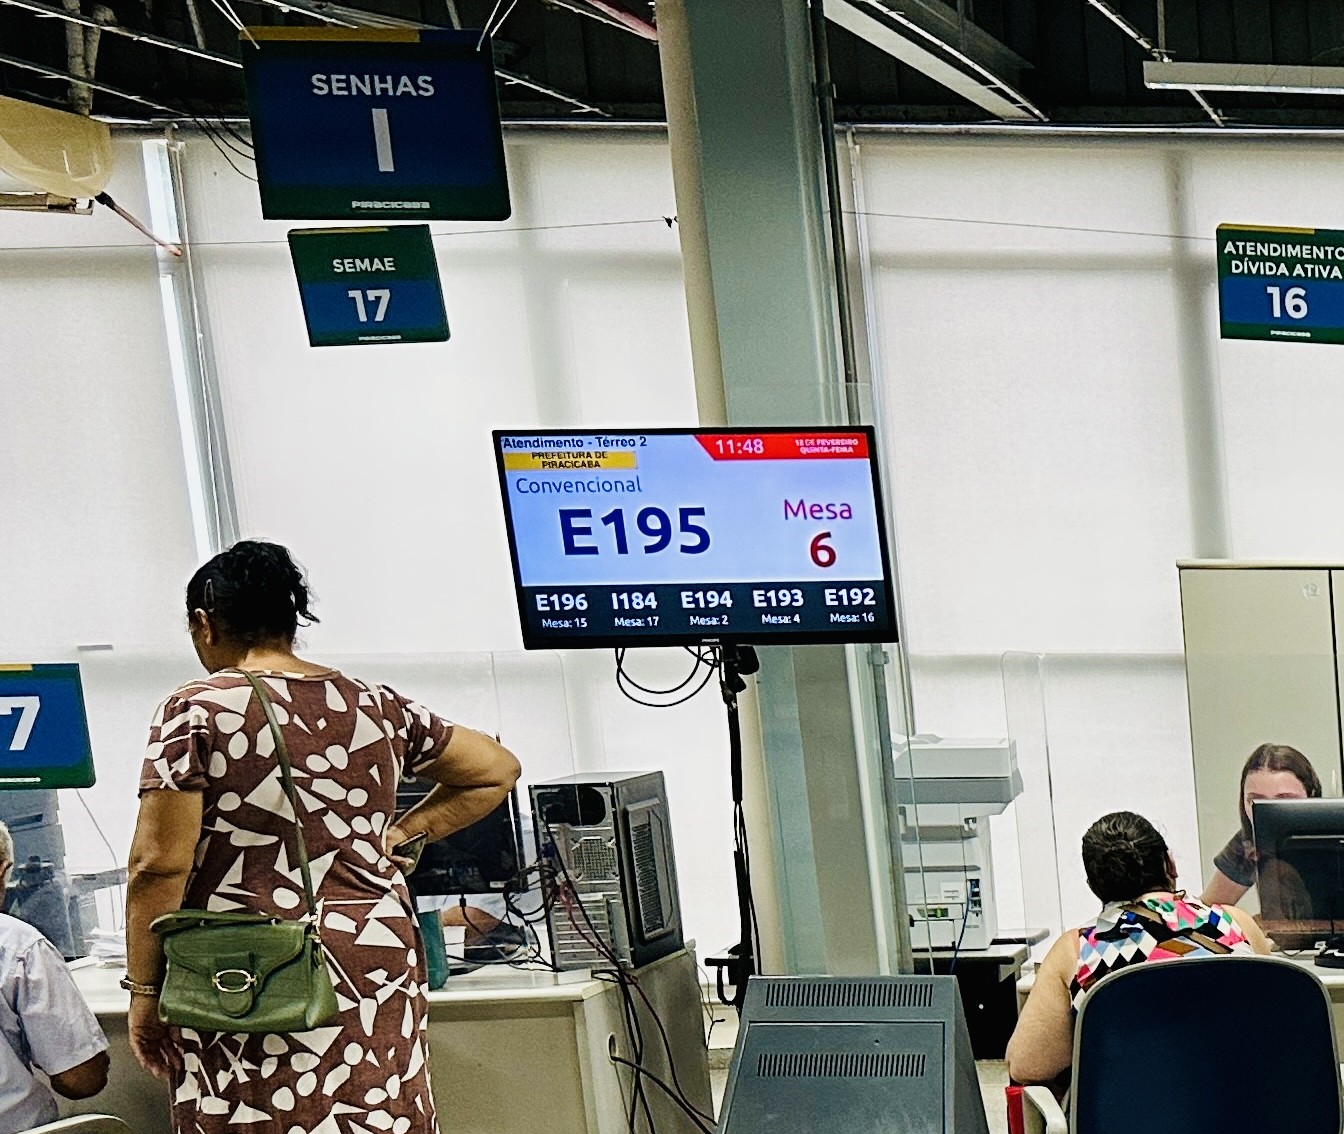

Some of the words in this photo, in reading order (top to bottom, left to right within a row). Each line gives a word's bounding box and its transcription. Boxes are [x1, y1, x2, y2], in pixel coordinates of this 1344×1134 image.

[311, 74, 435, 97] SENHAS
[372, 108, 394, 172] I
[333, 257, 396, 273] SEMAE
[1231, 257, 1289, 277] DÍVIDA
[1293, 263, 1343, 279] ATIVA
[348, 289, 390, 322] 17
[1267, 286, 1308, 319] 16
[503, 437, 583, 448] Atendimento
[595, 436, 636, 448] Térreo
[639, 436, 647, 447] 2
[716, 439, 764, 454] 11:48
[532, 452, 592, 460] PREFEITURA
[595, 451, 608, 459] DE
[542, 460, 600, 469] PIRACICABA
[516, 475, 642, 493] Convencional
[784, 499, 853, 520] Mesa
[559, 507, 711, 555] E195
[810, 531, 836, 568] 6
[535, 593, 588, 611] E196
[611, 592, 658, 610] I184
[680, 590, 733, 609] E194
[753, 589, 804, 607] E193
[824, 588, 876, 606] E192
[542, 618, 572, 628] Mesa:
[574, 617, 588, 628] 15
[614, 617, 645, 627] Mesa:
[647, 616, 659, 626] 17
[689, 615, 720, 626] Mesa:
[721, 615, 729, 625] 2
[761, 614, 791, 624] Mesa:
[793, 614, 800, 623] 4
[830, 613, 860, 623] Mesa:
[862, 612, 875, 622] 16
